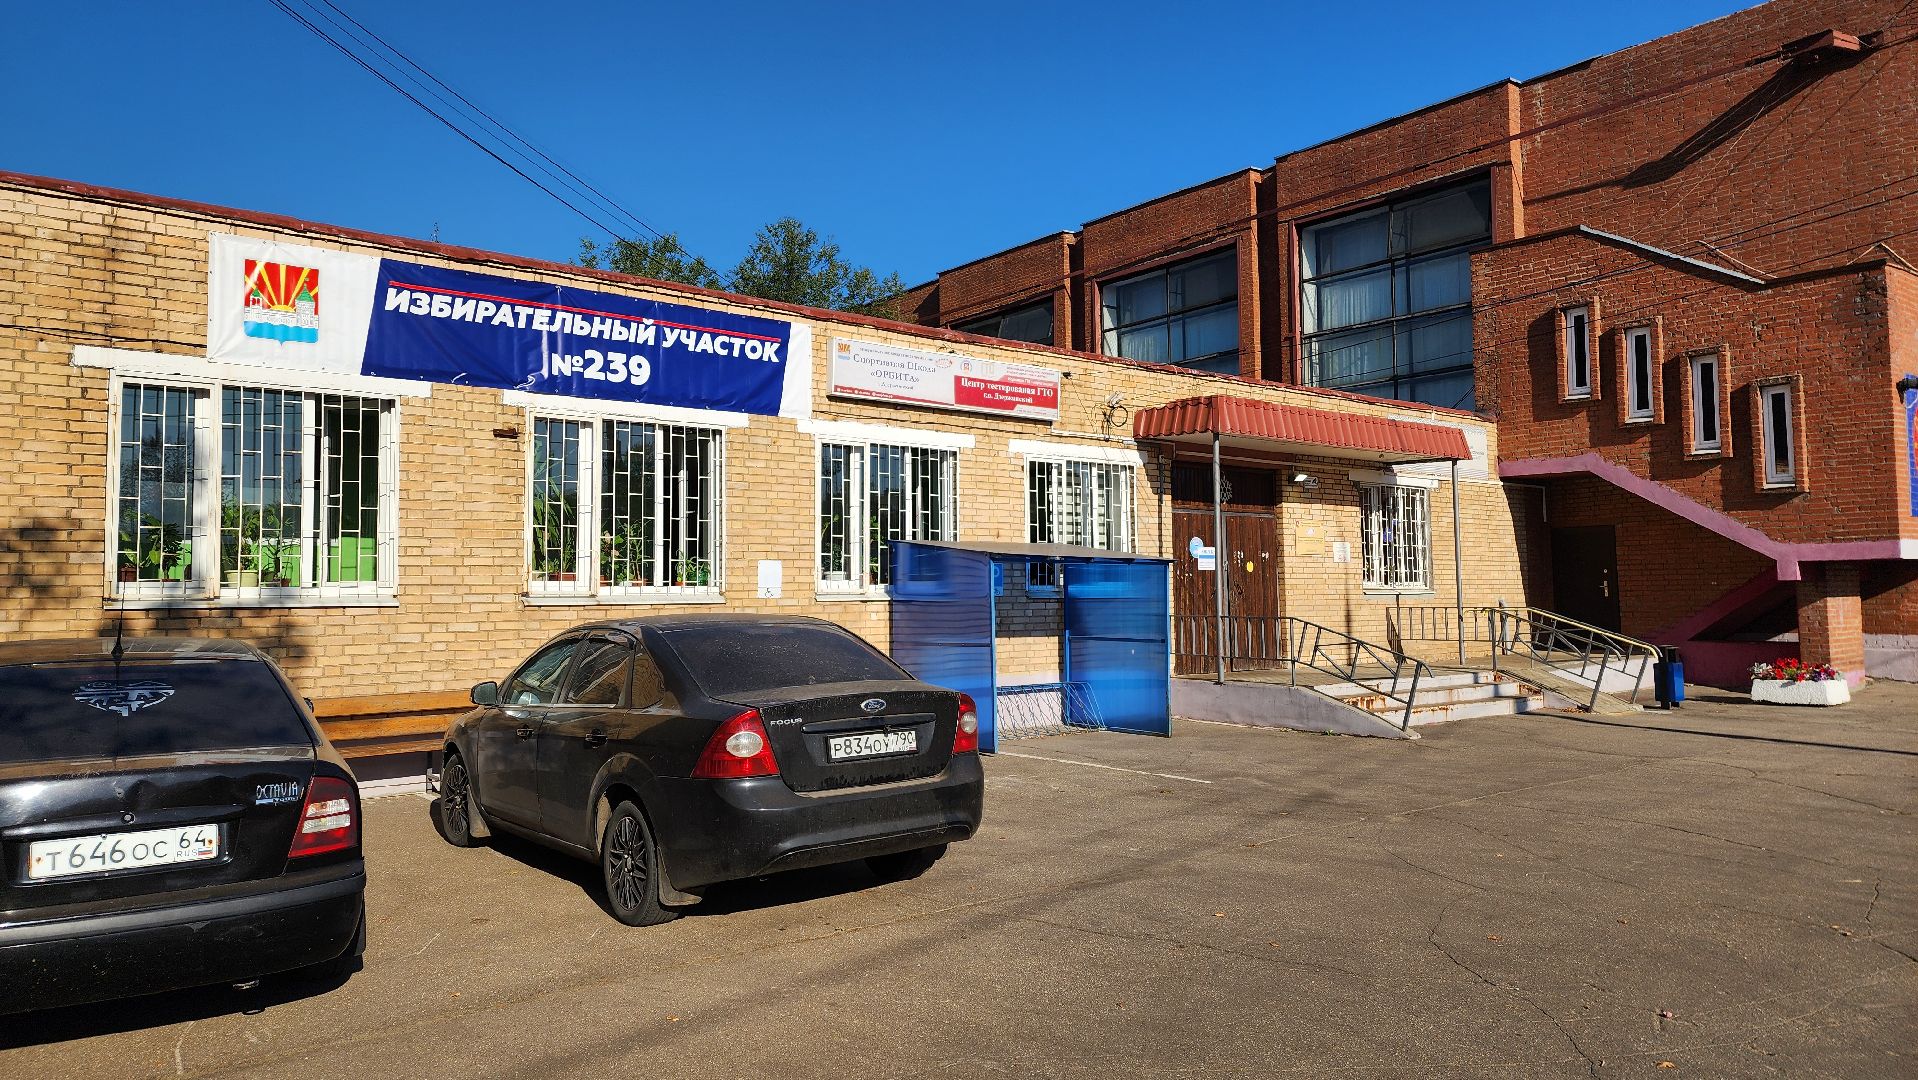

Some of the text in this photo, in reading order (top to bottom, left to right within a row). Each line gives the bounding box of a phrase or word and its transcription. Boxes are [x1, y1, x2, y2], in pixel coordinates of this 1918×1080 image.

[385, 287, 781, 364] ИЗБИРАТЕЛЬНЫЙ УЧАСТОК
[550, 349, 651, 386] №239
[853, 353, 905, 369] Спортивная
[907, 361, 936, 374] Школа
[961, 377, 985, 390] Центр
[1037, 388, 1053, 397] ГТО
[770, 717, 803, 726] FOCUS
[256, 781, 299, 799] OCTAVIA
[180, 829, 206, 849] 64
[176, 848, 198, 858] RUS
